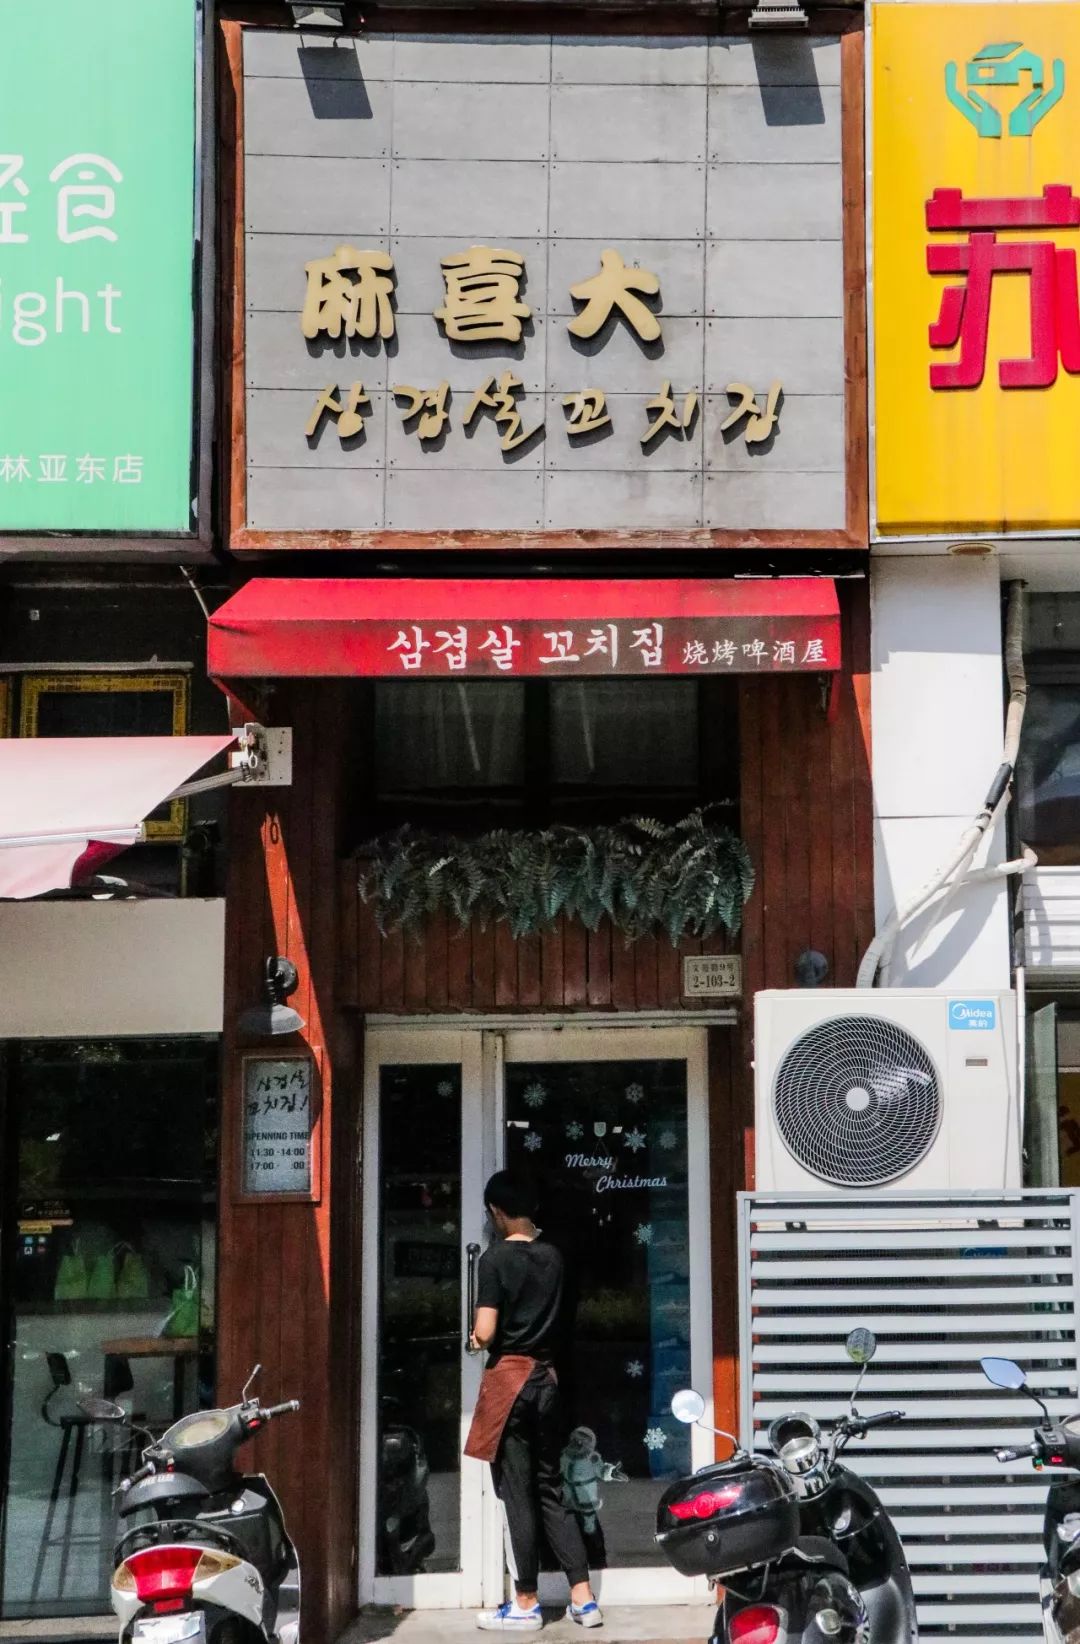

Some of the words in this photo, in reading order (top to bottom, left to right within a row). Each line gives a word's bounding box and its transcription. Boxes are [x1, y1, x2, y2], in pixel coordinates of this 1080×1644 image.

[301, 244, 662, 342] 麻喜大
[925, 184, 1080, 389] 苏
[0, 454, 144, 483] 林亚东店
[386, 625, 521, 670] 삼겹살
[539, 623, 665, 669] 꼬치집
[682, 638, 828, 666] 烧烤啤酒屋
[693, 974, 736, 988] 2-103-2
[955, 1005, 993, 1018] Midea
[565, 1154, 613, 1169] Merry
[596, 1175, 668, 1192] Christmas
